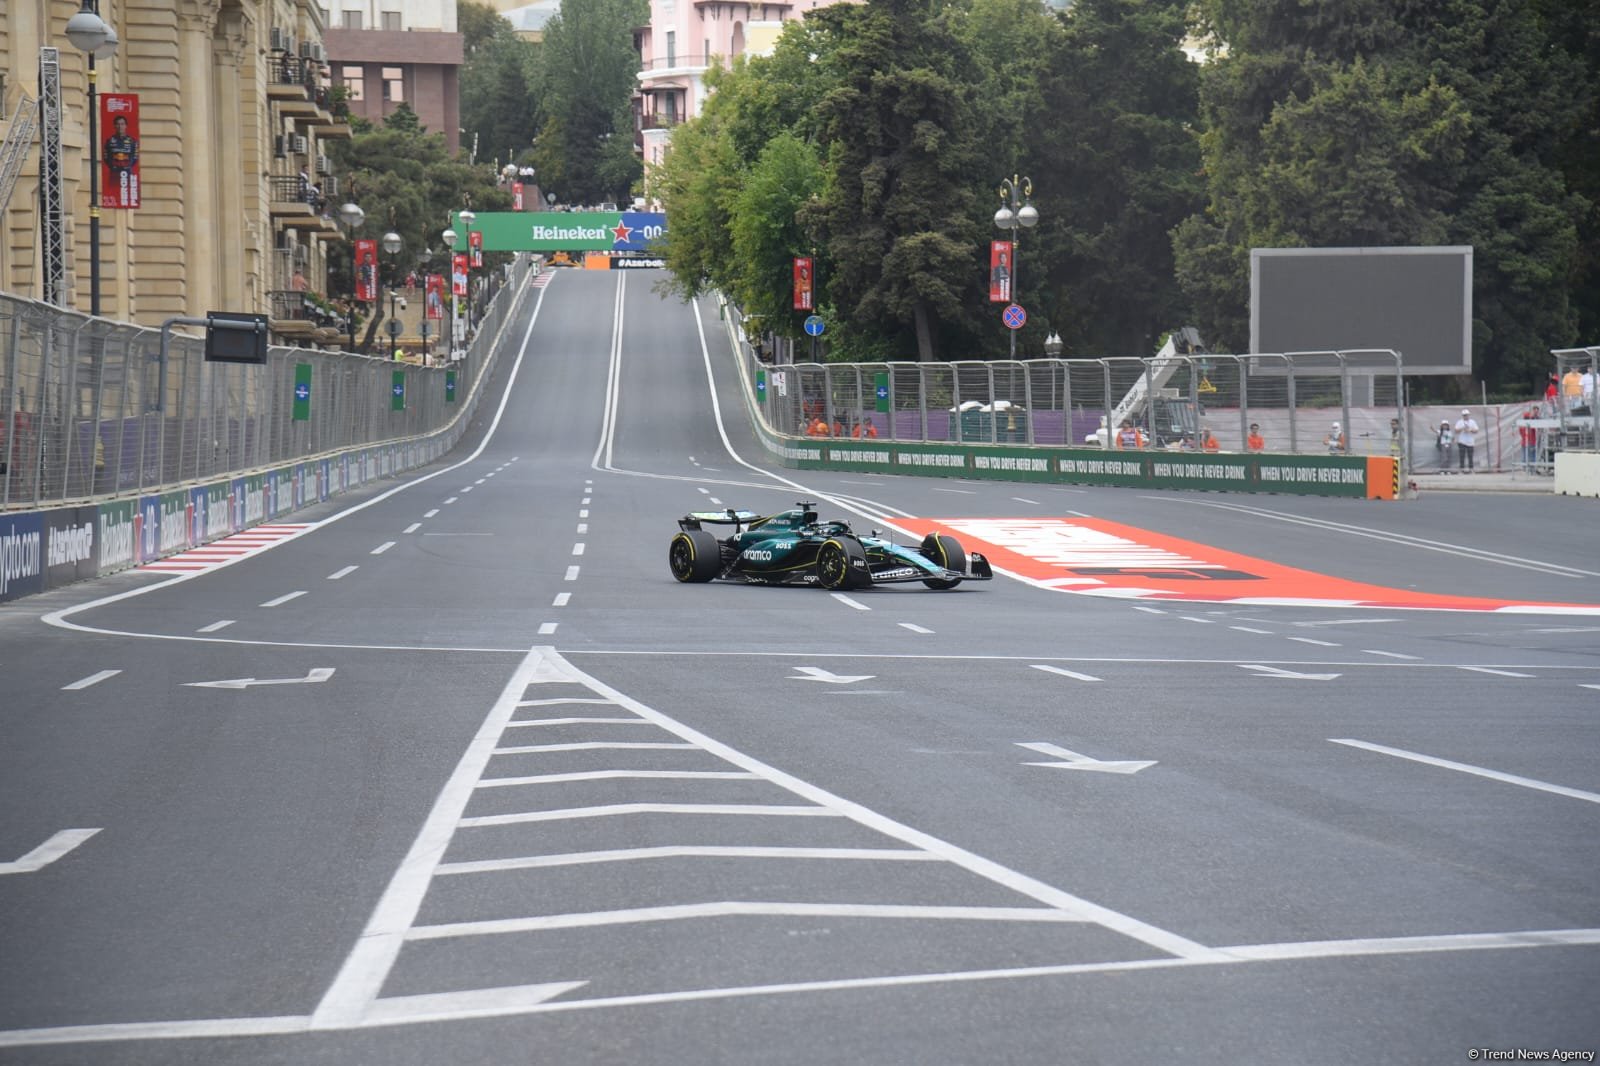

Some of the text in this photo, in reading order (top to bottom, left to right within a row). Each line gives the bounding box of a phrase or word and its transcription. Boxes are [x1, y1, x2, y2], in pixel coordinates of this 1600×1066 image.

[120, 171, 128, 206] SERGIO
[130, 174, 138, 206] PEREZ
[532, 225, 606, 240] Heineken
[975, 457, 1047, 472] WHEN YOU DRIVE NEVER DRINK
[1060, 460, 1141, 475] WHEN YOU DRIVE NEVER DRINK
[1154, 464, 1245, 479] WHEN YOU DRIVE NEVER DRINK
[1260, 466, 1364, 483] WHEN YOU DRIVE NEVER DRINK
[101, 509, 133, 568] Heineken
[744, 550, 772, 561] aramco
